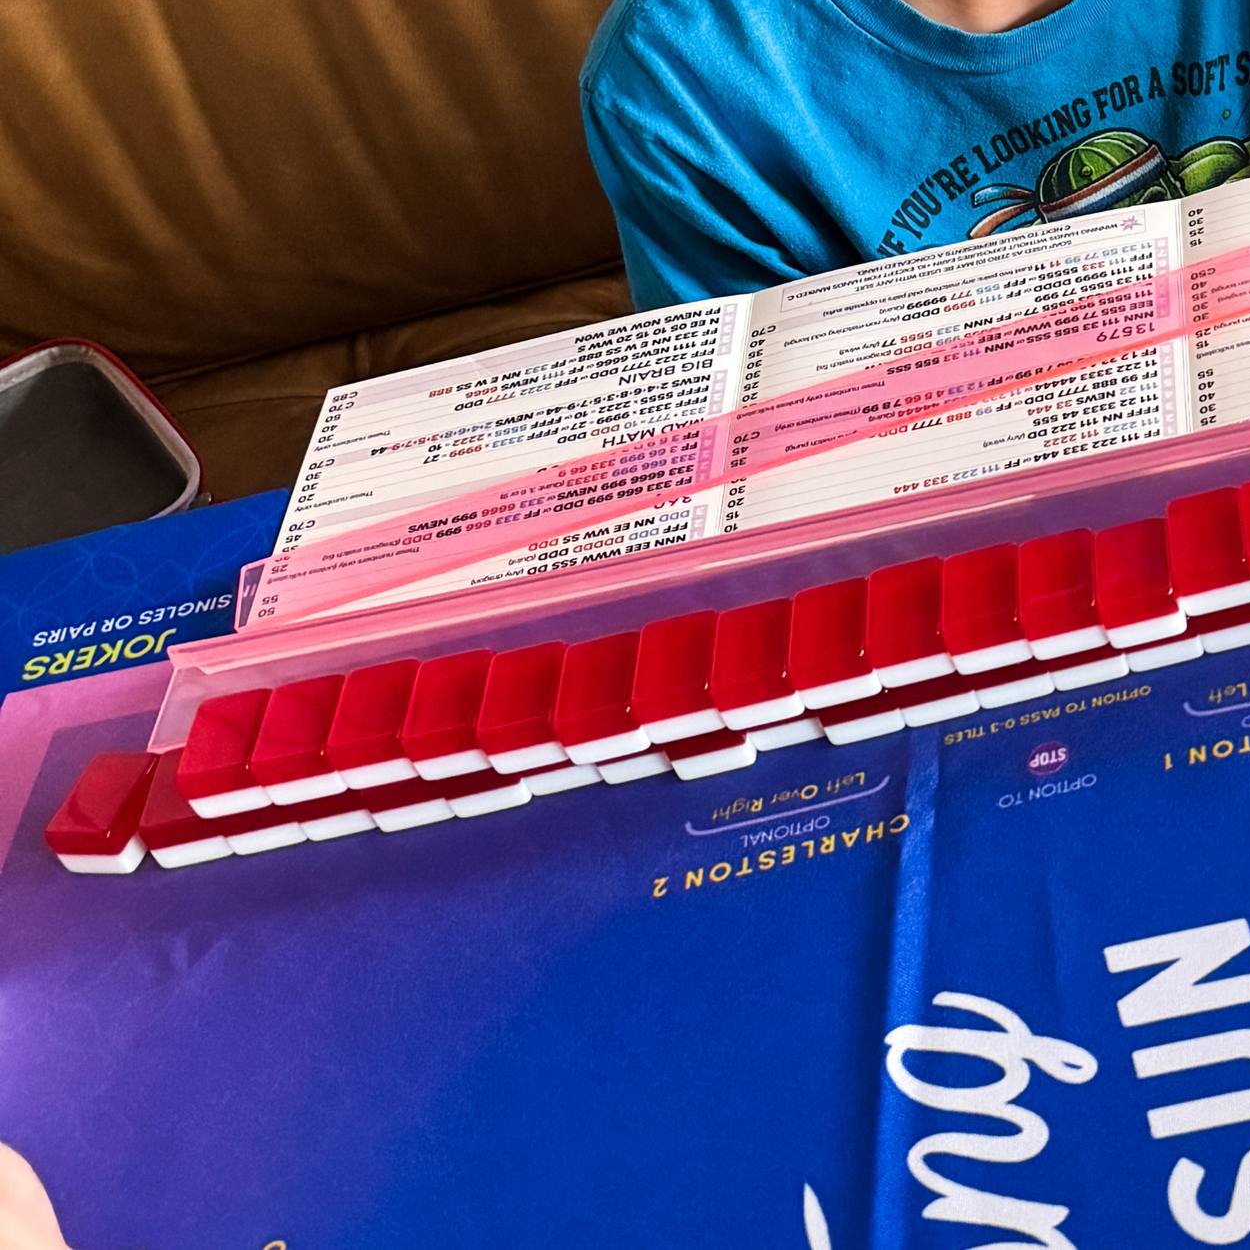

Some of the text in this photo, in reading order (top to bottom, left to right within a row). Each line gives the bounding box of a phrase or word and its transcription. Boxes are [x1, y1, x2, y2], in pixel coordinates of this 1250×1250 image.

[891, 154, 981, 240] YOU'RE
[972, 97, 1091, 174] LOOKING
[1092, 75, 1144, 120] FOR
[1148, 67, 1166, 99] A
[1171, 54, 1230, 96] SOFT
[1096, 322, 1155, 342] 13579
[618, 358, 713, 385] BIG BRAIN
[1027, 404, 1159, 439] FFFF NN 111 222 DD
[1043, 416, 1159, 447] 111 2222 111 2222
[602, 427, 655, 448] MATH
[1092, 436, 1117, 448] 222
[1121, 432, 1139, 442] 111
[1143, 428, 1160, 438] FF
[1033, 450, 1059, 462] 444
[1062, 443, 1088, 455] 333
[952, 468, 977, 480] 222
[981, 463, 1000, 474] 111
[1004, 458, 1020, 469] FF
[923, 474, 948, 487] 333
[628, 527, 659, 540] DDD
[662, 521, 688, 533] FFF
[526, 533, 686, 575] NNN EEE WWW SSS DD
[537, 547, 569, 561] DDD
[33, 594, 232, 647] SINGLES OR PAIRS
[22, 628, 176, 680] JOKERS
[1208, 683, 1247, 704] Left
[944, 685, 1152, 745] OPTION TO PASS 0-3 TILES
[1029, 748, 1067, 769] STOP
[1163, 753, 1173, 770] 1
[712, 771, 865, 821] Left Over Right
[998, 774, 1096, 808] OPTION TO
[740, 815, 830, 848] OPTIONAL
[651, 814, 910, 898] CHARLESTON 2
[884, 991, 1098, 1250] ng
